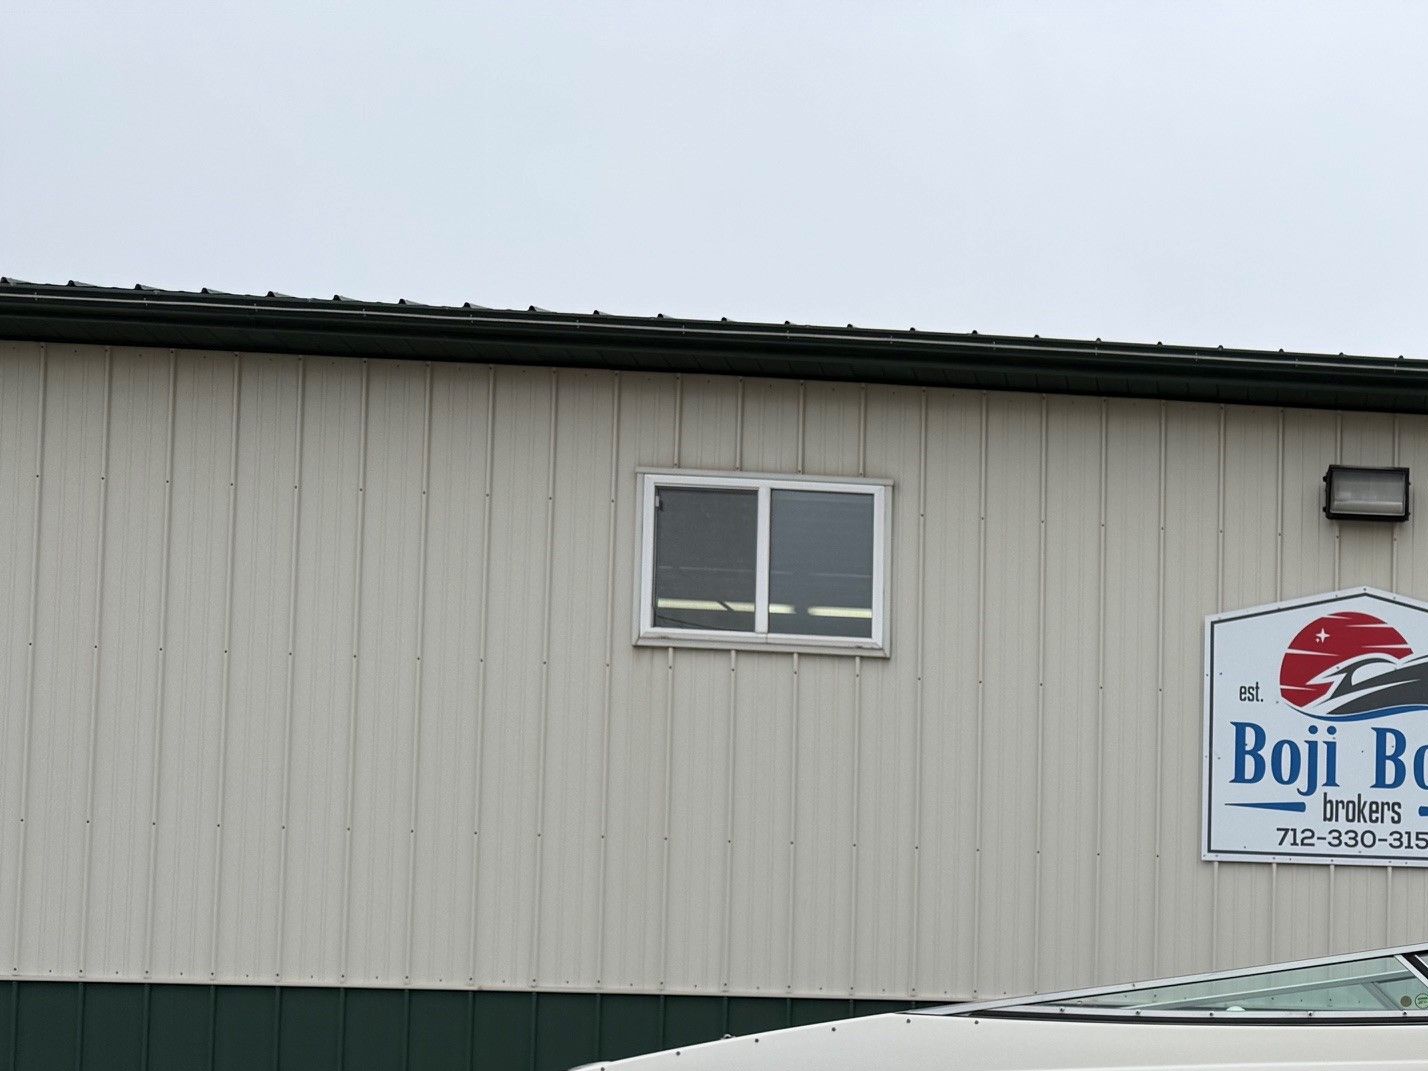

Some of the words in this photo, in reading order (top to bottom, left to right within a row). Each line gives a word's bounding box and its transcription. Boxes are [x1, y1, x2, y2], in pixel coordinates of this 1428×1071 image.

[1239, 681, 1264, 702] est.
[1229, 721, 1340, 796] Boji
[1322, 792, 1402, 824] brokers
